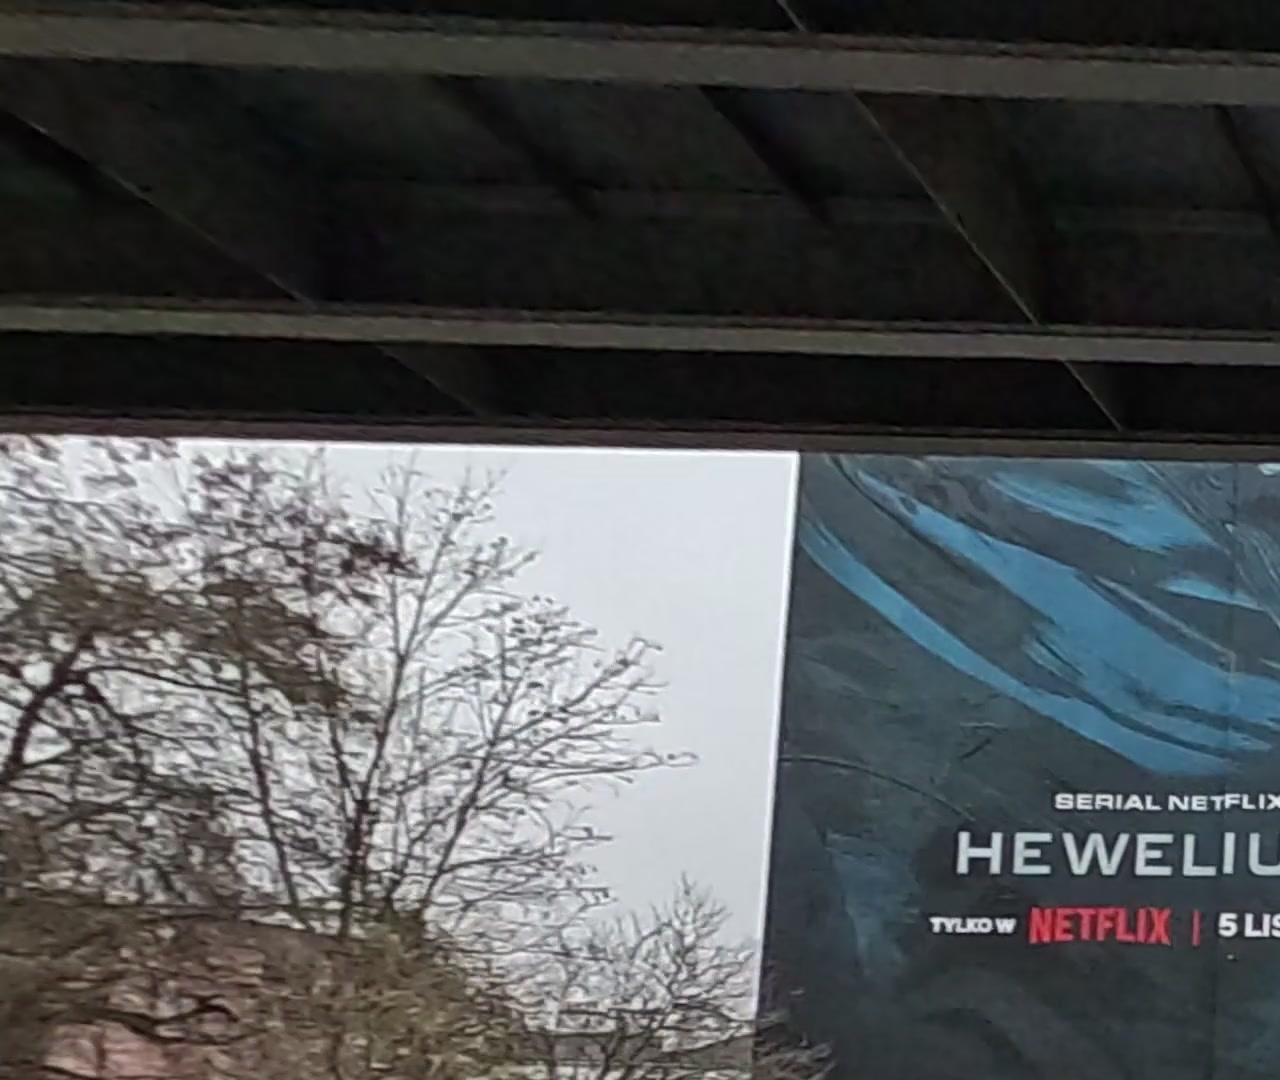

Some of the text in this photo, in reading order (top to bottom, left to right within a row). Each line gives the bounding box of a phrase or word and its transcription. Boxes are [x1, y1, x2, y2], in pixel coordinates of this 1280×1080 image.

[1053, 793, 1163, 811] SERIAL
[929, 907, 1172, 945] TYLKO W NETFLIX
[1218, 912, 1239, 938] 5
